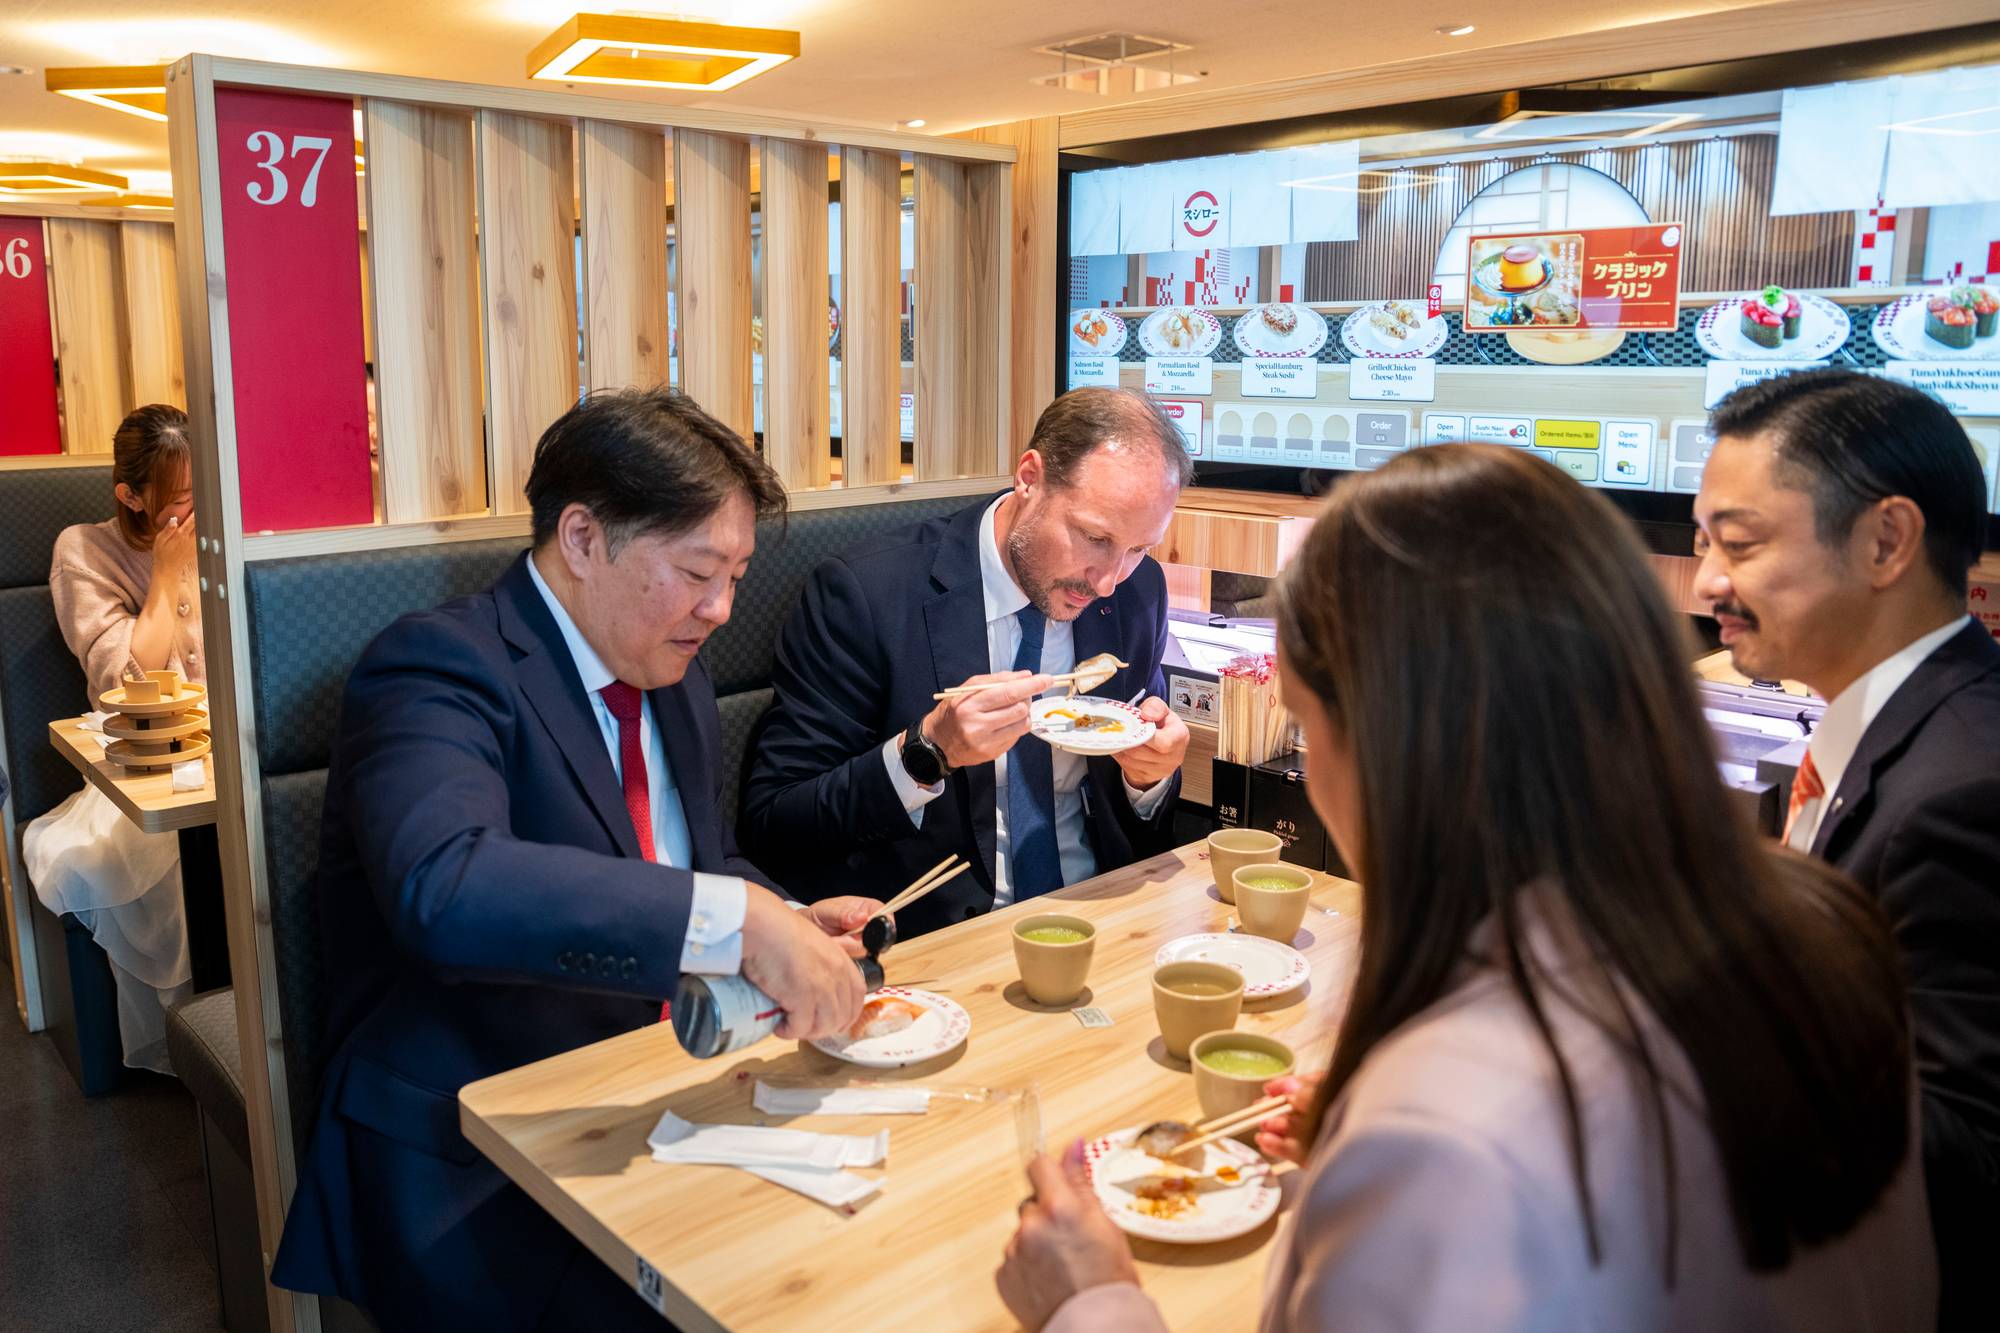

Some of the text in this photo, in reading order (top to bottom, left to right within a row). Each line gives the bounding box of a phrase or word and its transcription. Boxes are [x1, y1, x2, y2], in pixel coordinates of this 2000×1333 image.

[246, 131, 332, 207] 37
[1184, 209, 1219, 220] スシロー
[0, 238, 32, 279] 6
[1593, 261, 1668, 280] クラシック
[1605, 282, 1652, 299] プリン
[1368, 363, 1417, 372] GrilledChicken
[1739, 367, 1762, 376] Tuna
[1371, 373, 1413, 383] Cheese Mayo
[1370, 420, 1392, 430] Order
[1437, 423, 1454, 431] Open
[1540, 430, 1564, 438] Ordered
[1618, 431, 1638, 439] Open
[1219, 804, 1238, 818] お箸
[1276, 819, 1296, 833] がり
